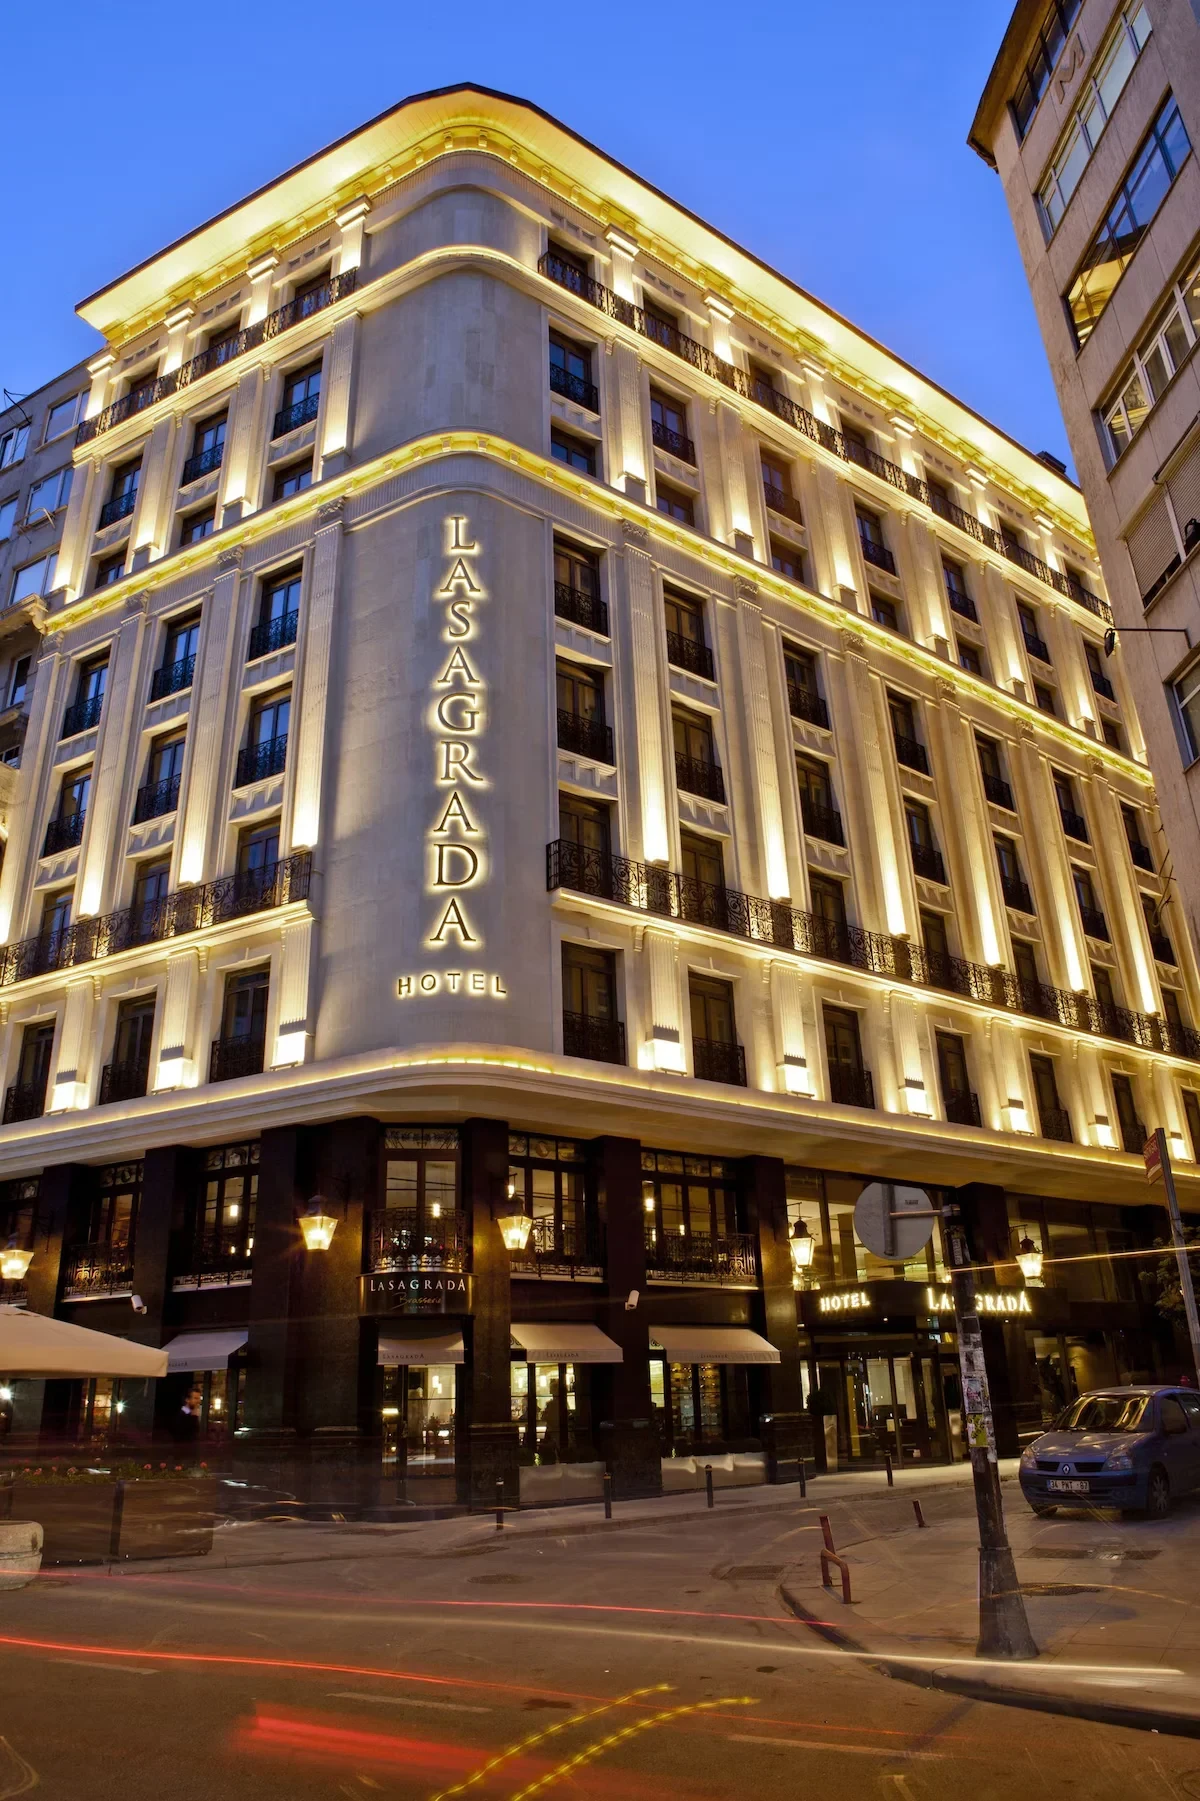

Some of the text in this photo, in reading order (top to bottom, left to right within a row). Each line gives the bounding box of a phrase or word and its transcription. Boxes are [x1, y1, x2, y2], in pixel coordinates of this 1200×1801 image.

[430, 516, 484, 943] LASAGRADA
[398, 972, 507, 997] HOTEL
[370, 1279, 466, 1292] LASAGRADA
[820, 1287, 1032, 1312] HOTEL LAGRADA
